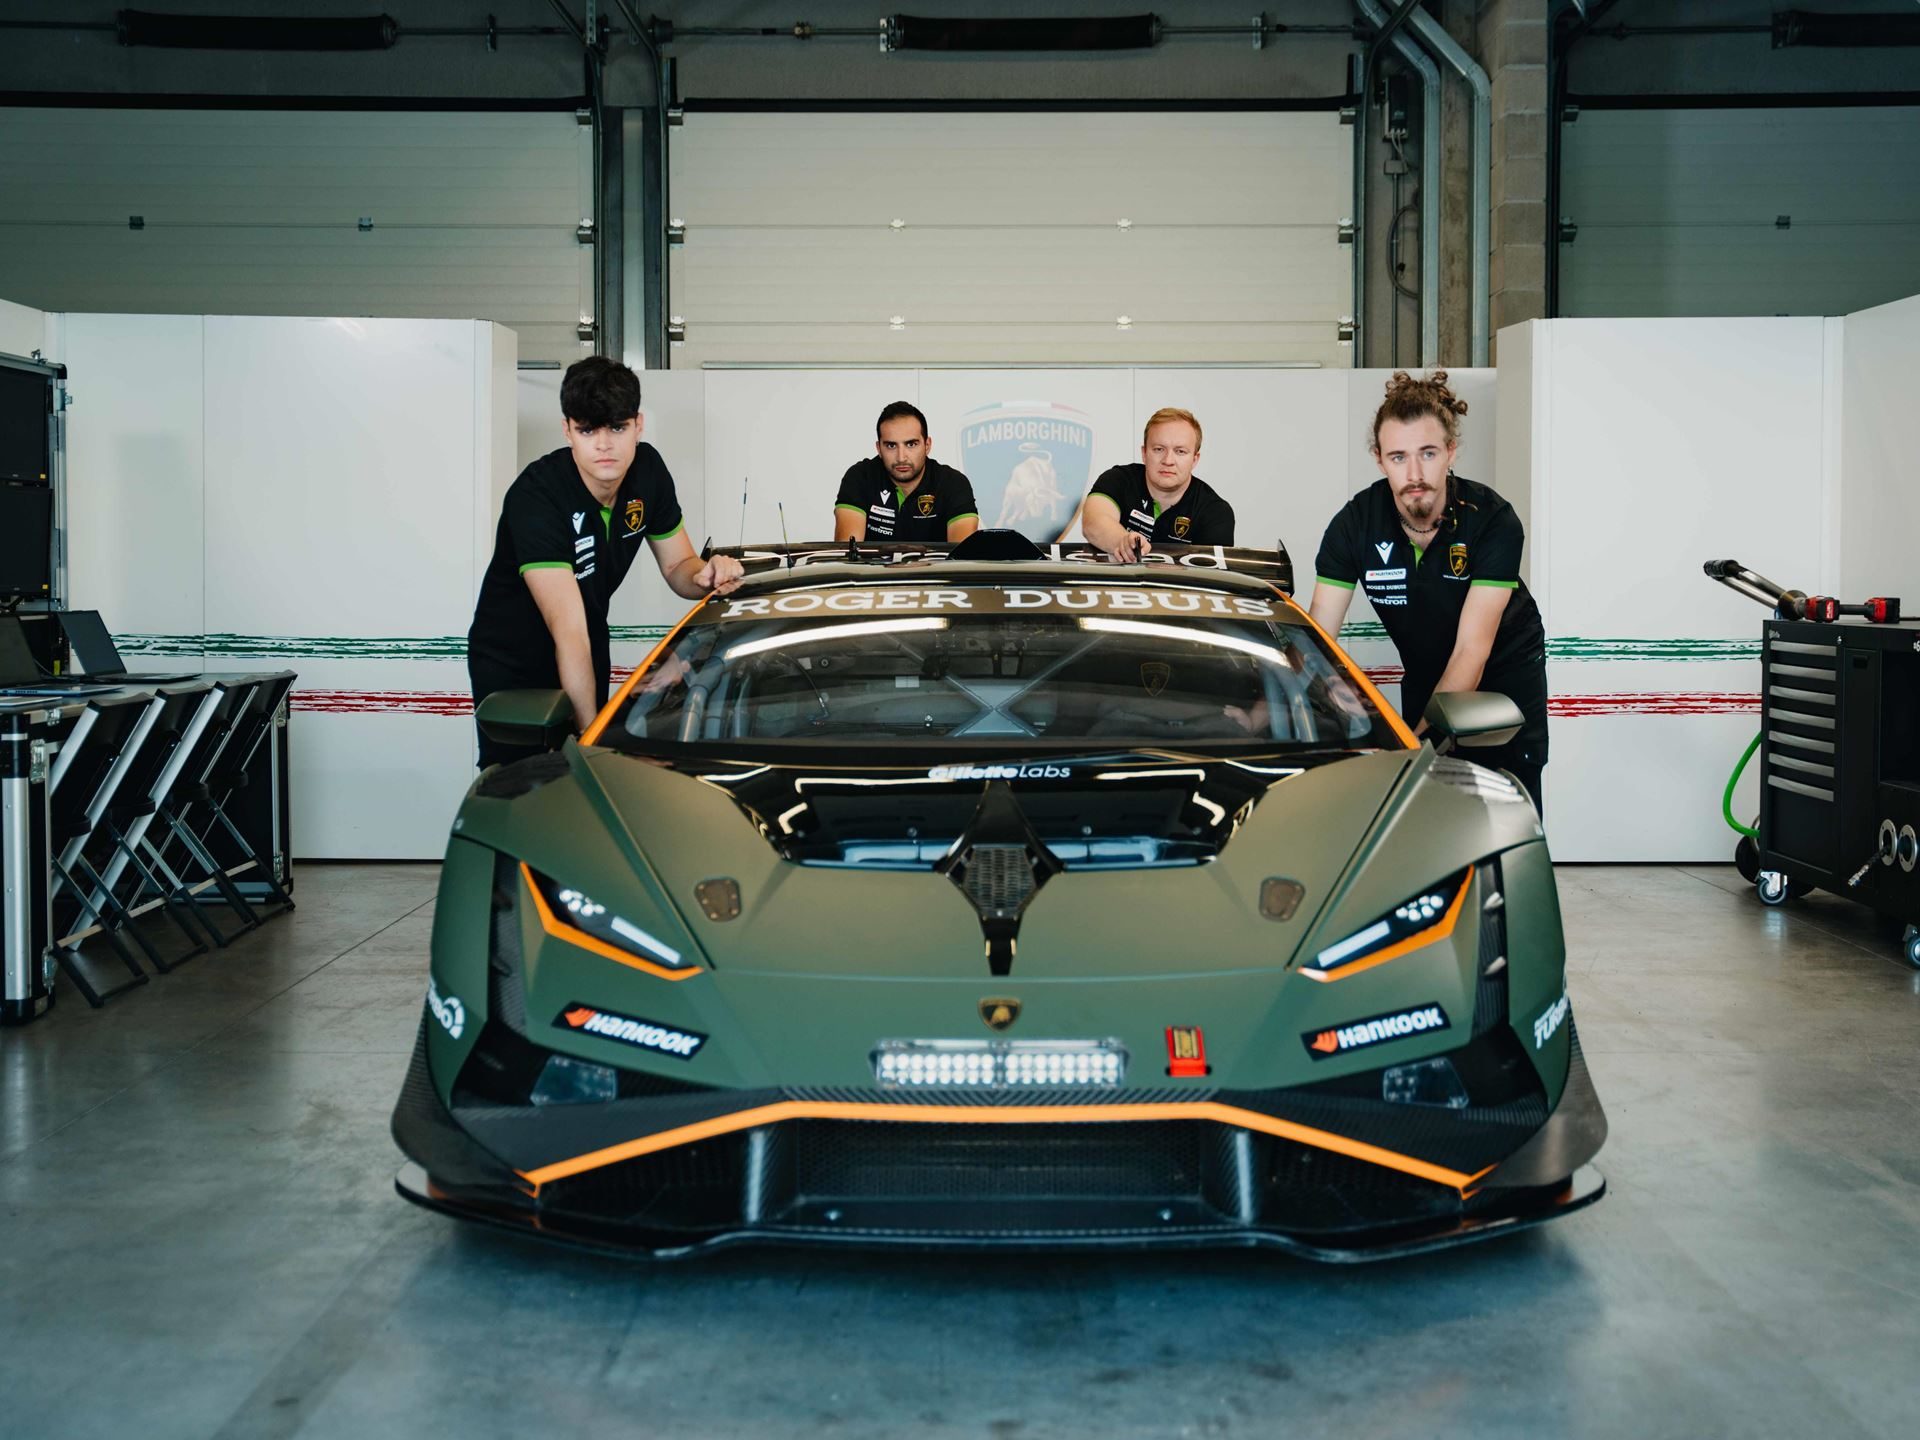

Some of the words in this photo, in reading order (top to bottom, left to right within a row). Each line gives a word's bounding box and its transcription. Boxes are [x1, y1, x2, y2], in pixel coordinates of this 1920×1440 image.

[967, 421, 1087, 449] LAMBORGHINI
[720, 589, 973, 618] ROGER
[1003, 589, 1275, 617] DUBUIS
[1367, 595, 1408, 605] Fastron
